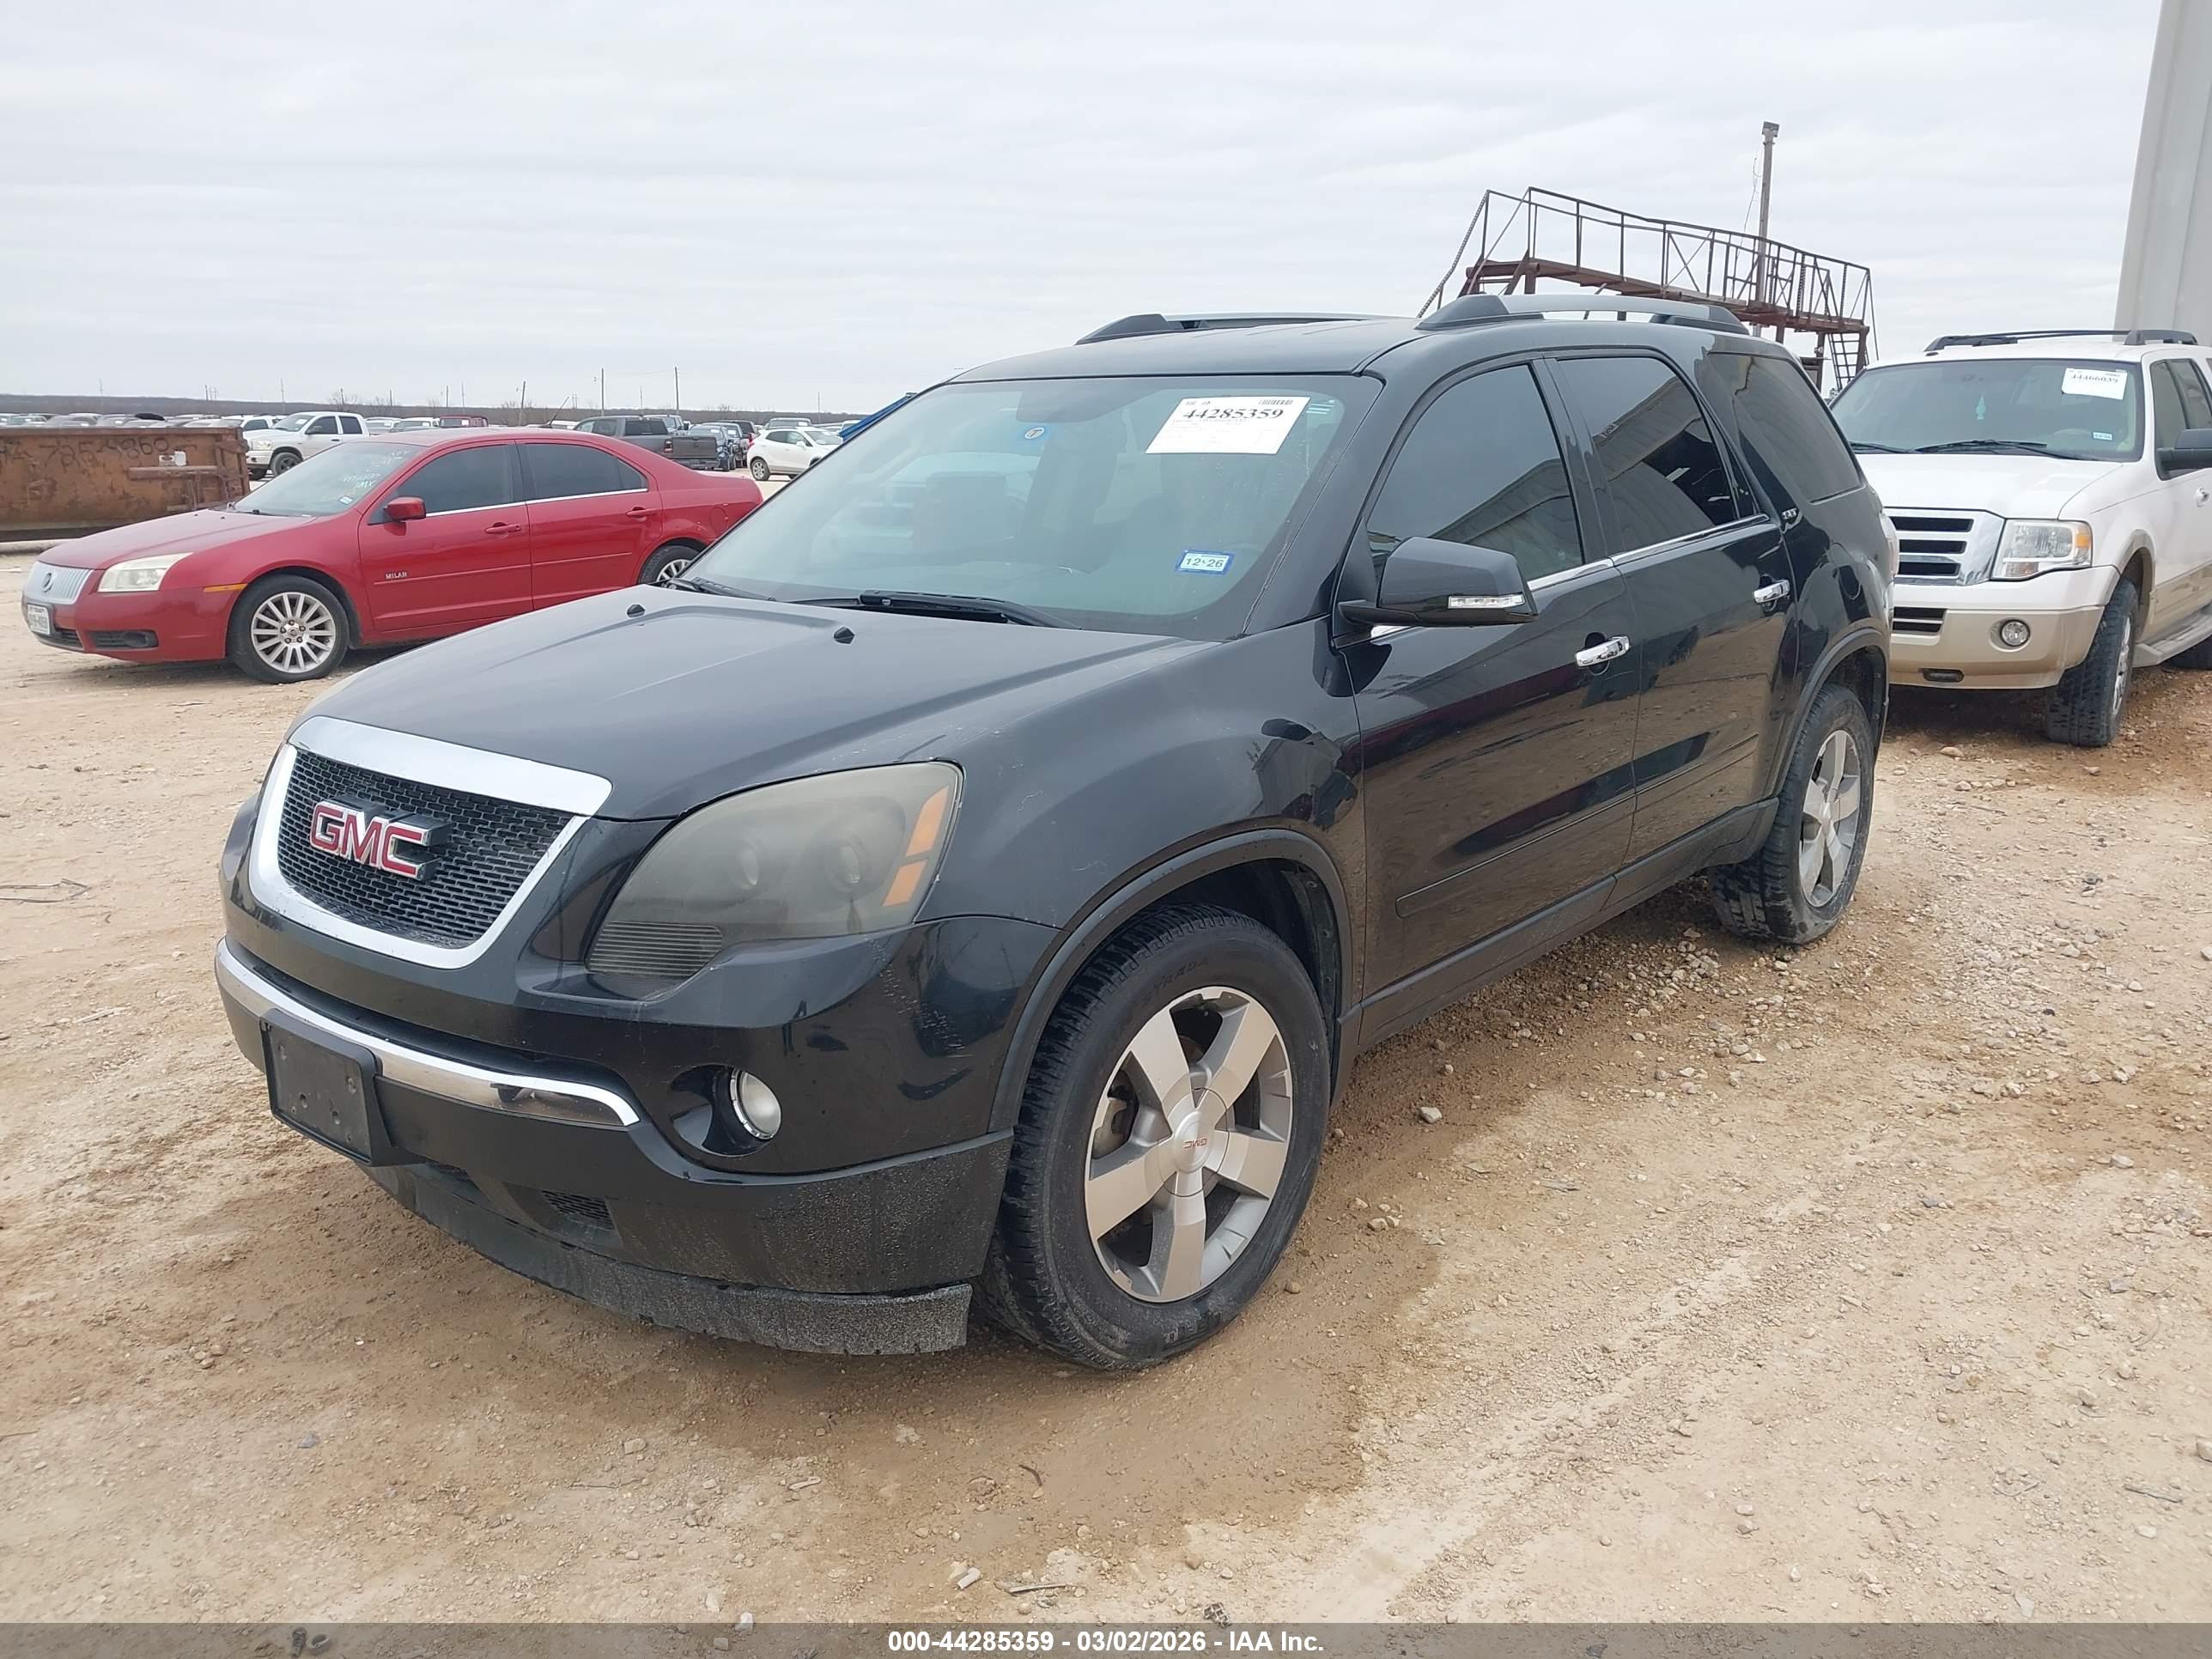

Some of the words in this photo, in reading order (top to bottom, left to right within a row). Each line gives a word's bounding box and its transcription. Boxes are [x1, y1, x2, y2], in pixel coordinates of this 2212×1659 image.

[1183, 409, 1284, 419] 44285359
[385, 571, 408, 580] MILAN
[309, 799, 429, 881] GMC
[1182, 1137, 1207, 1149] GMC
